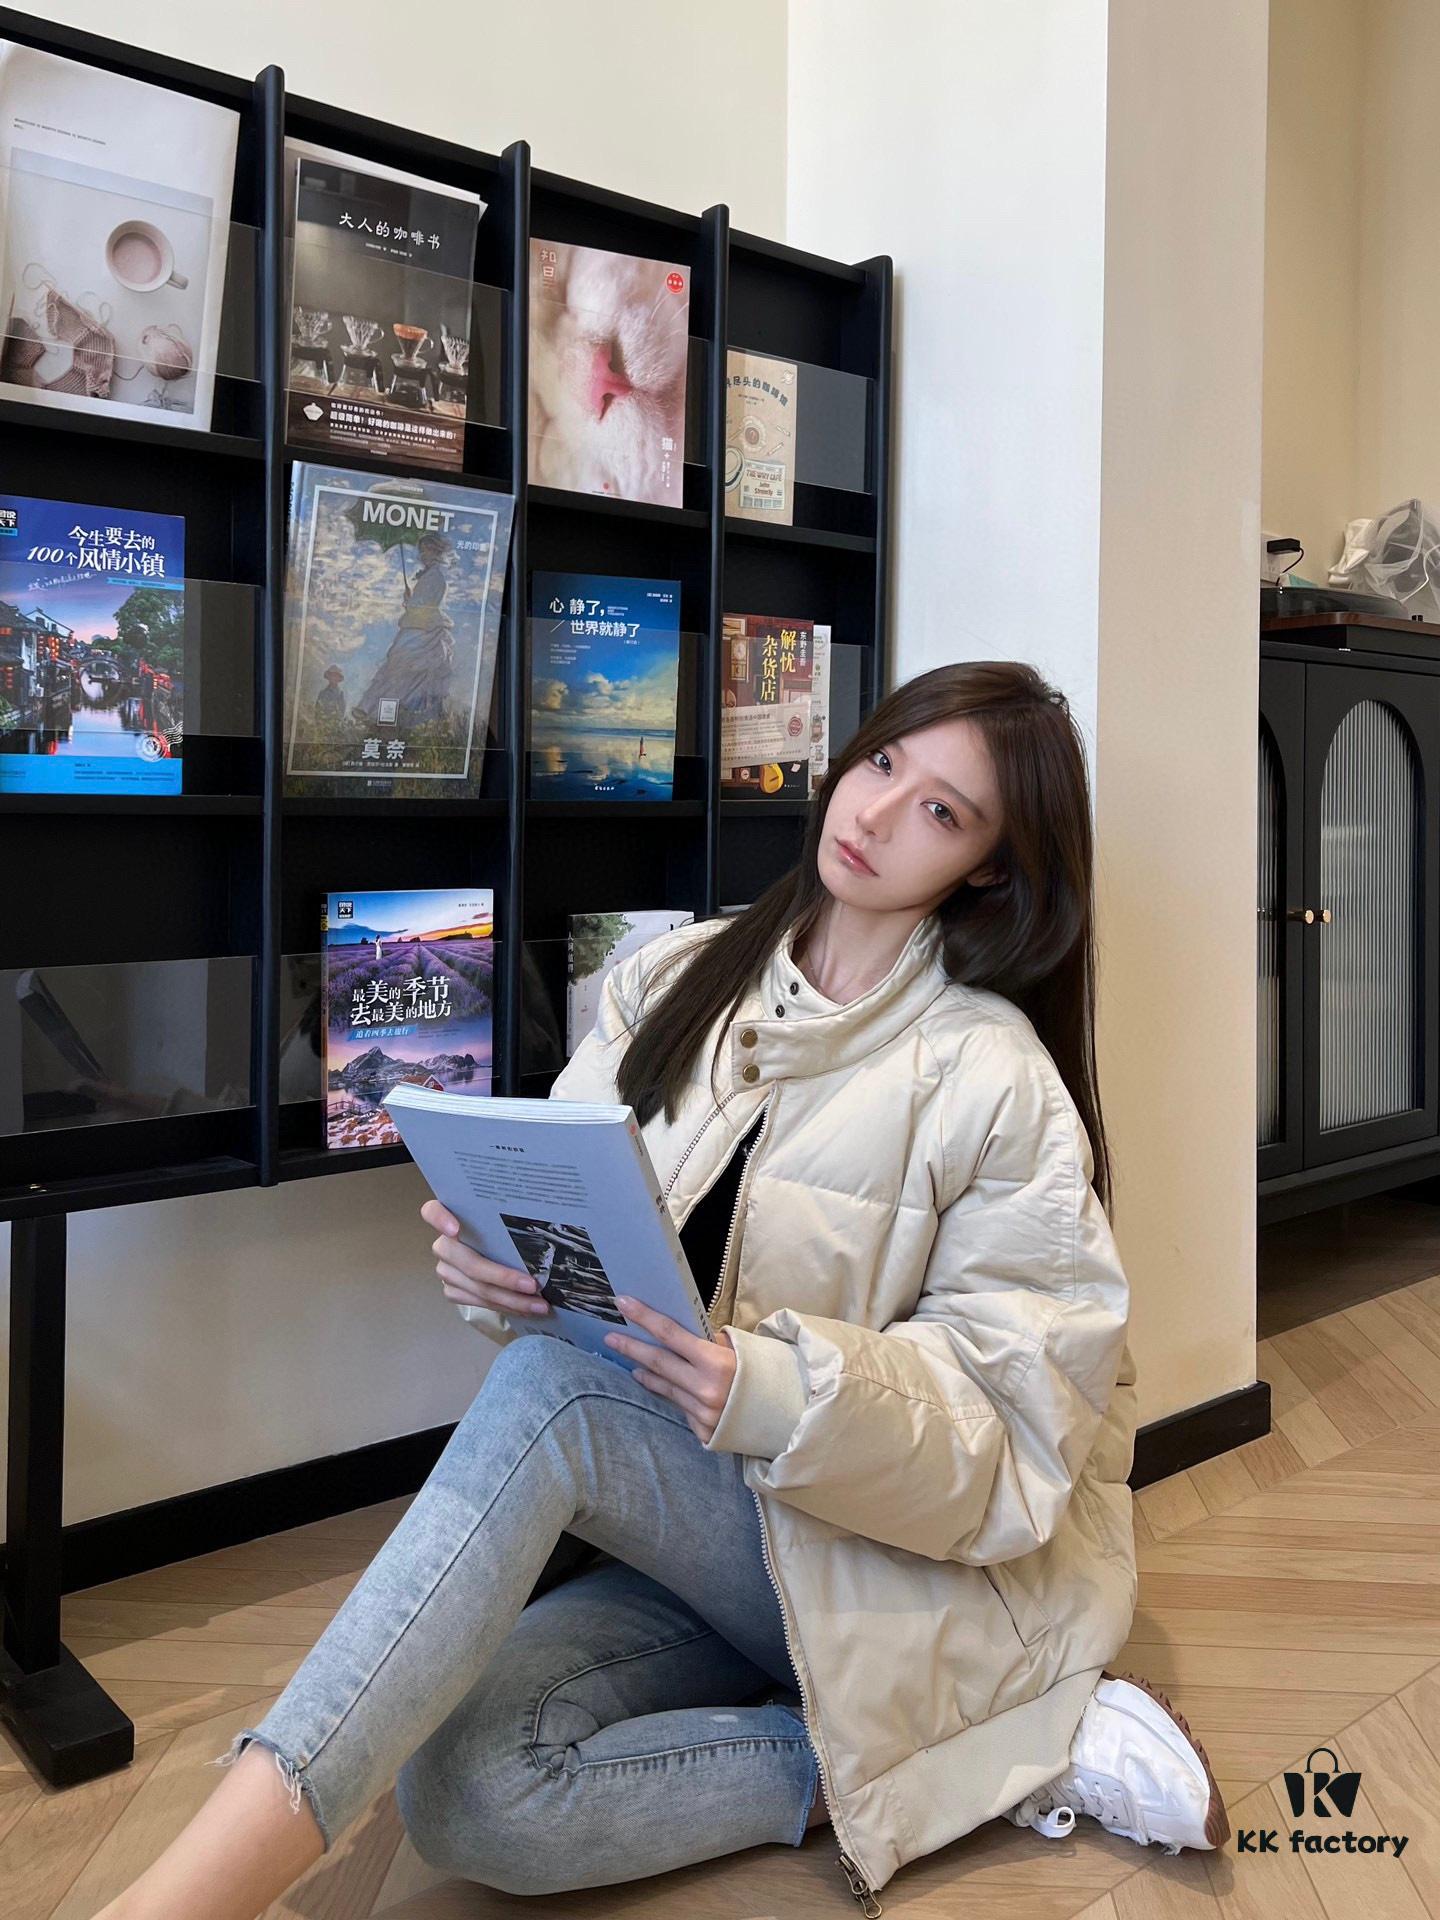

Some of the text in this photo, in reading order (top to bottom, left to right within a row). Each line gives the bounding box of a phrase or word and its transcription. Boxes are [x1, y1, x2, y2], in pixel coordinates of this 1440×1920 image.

[339, 212, 440, 250] 大人的咖啡书
[362, 500, 454, 533] MONET
[68, 525, 156, 551] 今生要去的
[26, 546, 166, 578] 100个风情小镇
[570, 619, 641, 638] 世界就静了
[780, 629, 796, 673] 解忧
[760, 635, 778, 702] 杂货店
[361, 738, 406, 759] 莫奈
[352, 976, 450, 1005] 最美的季节
[350, 999, 453, 1026] 去最美的地方
